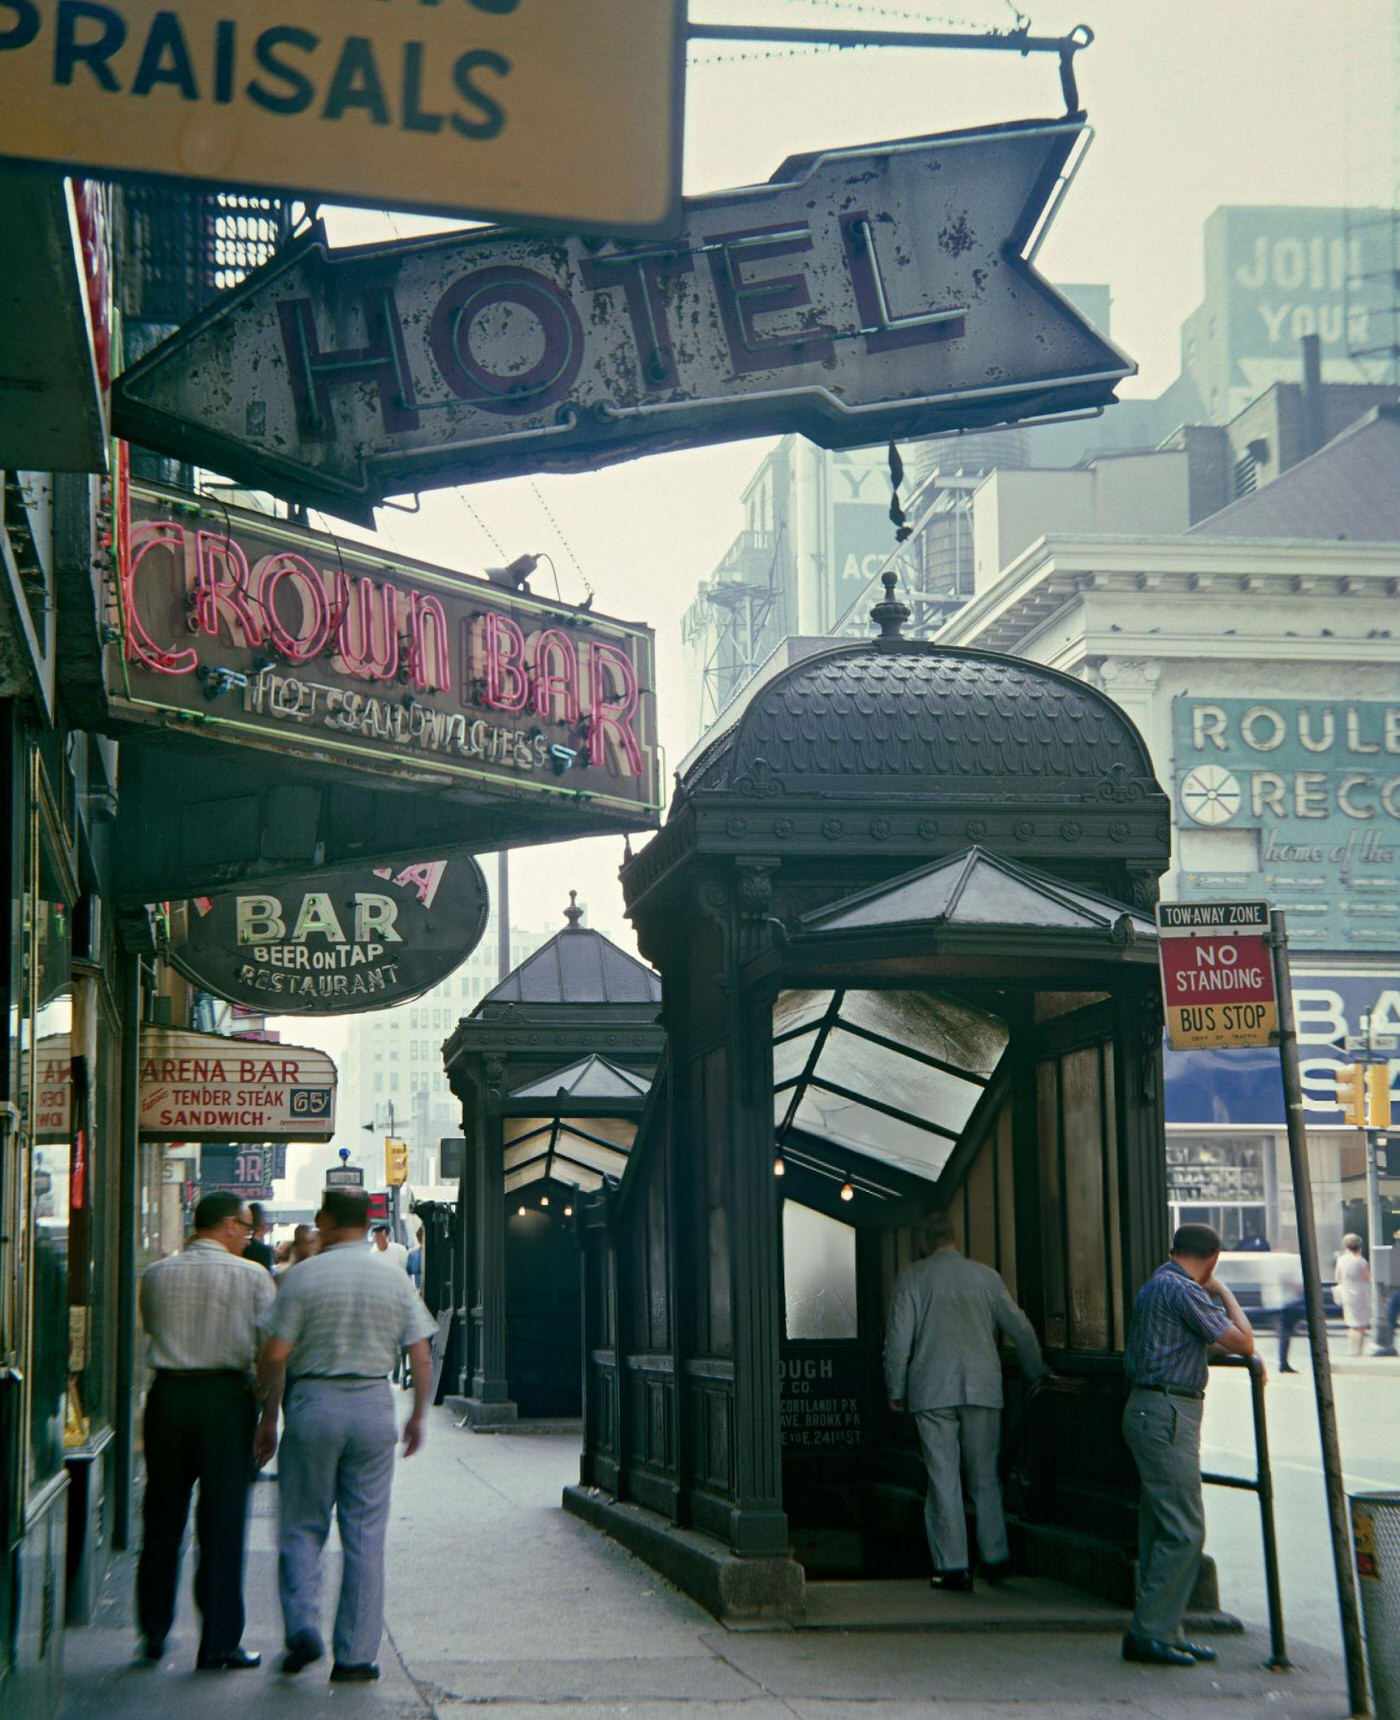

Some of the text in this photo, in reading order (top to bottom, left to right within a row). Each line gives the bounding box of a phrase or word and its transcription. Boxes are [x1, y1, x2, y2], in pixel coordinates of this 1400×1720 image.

[1235, 236, 1362, 290] JOIN
[276, 210, 968, 442] HOTEL
[1257, 303, 1370, 343] YOUR
[244, 663, 345, 718] HOT
[472, 609, 643, 778] BAR
[1264, 828, 1394, 873] home of the
[236, 892, 404, 946] BAR
[1229, 905, 1262, 924] ZONE
[254, 944, 309, 970] BEER
[335, 943, 384, 969] TAP
[1196, 945, 1238, 967] NO
[238, 963, 399, 998] RESTAURANT
[1176, 967, 1263, 992] STANDING
[1180, 1004, 1266, 1032] BUS STOP
[139, 1058, 300, 1084] ARENA BAR
[172, 1089, 230, 1107] TENDER
[236, 1089, 284, 1107] STEAK
[160, 1109, 264, 1126] SANDWICH
[780, 1399, 837, 1413] CORTLANDT
[805, 1413, 842, 1427] BRONX
